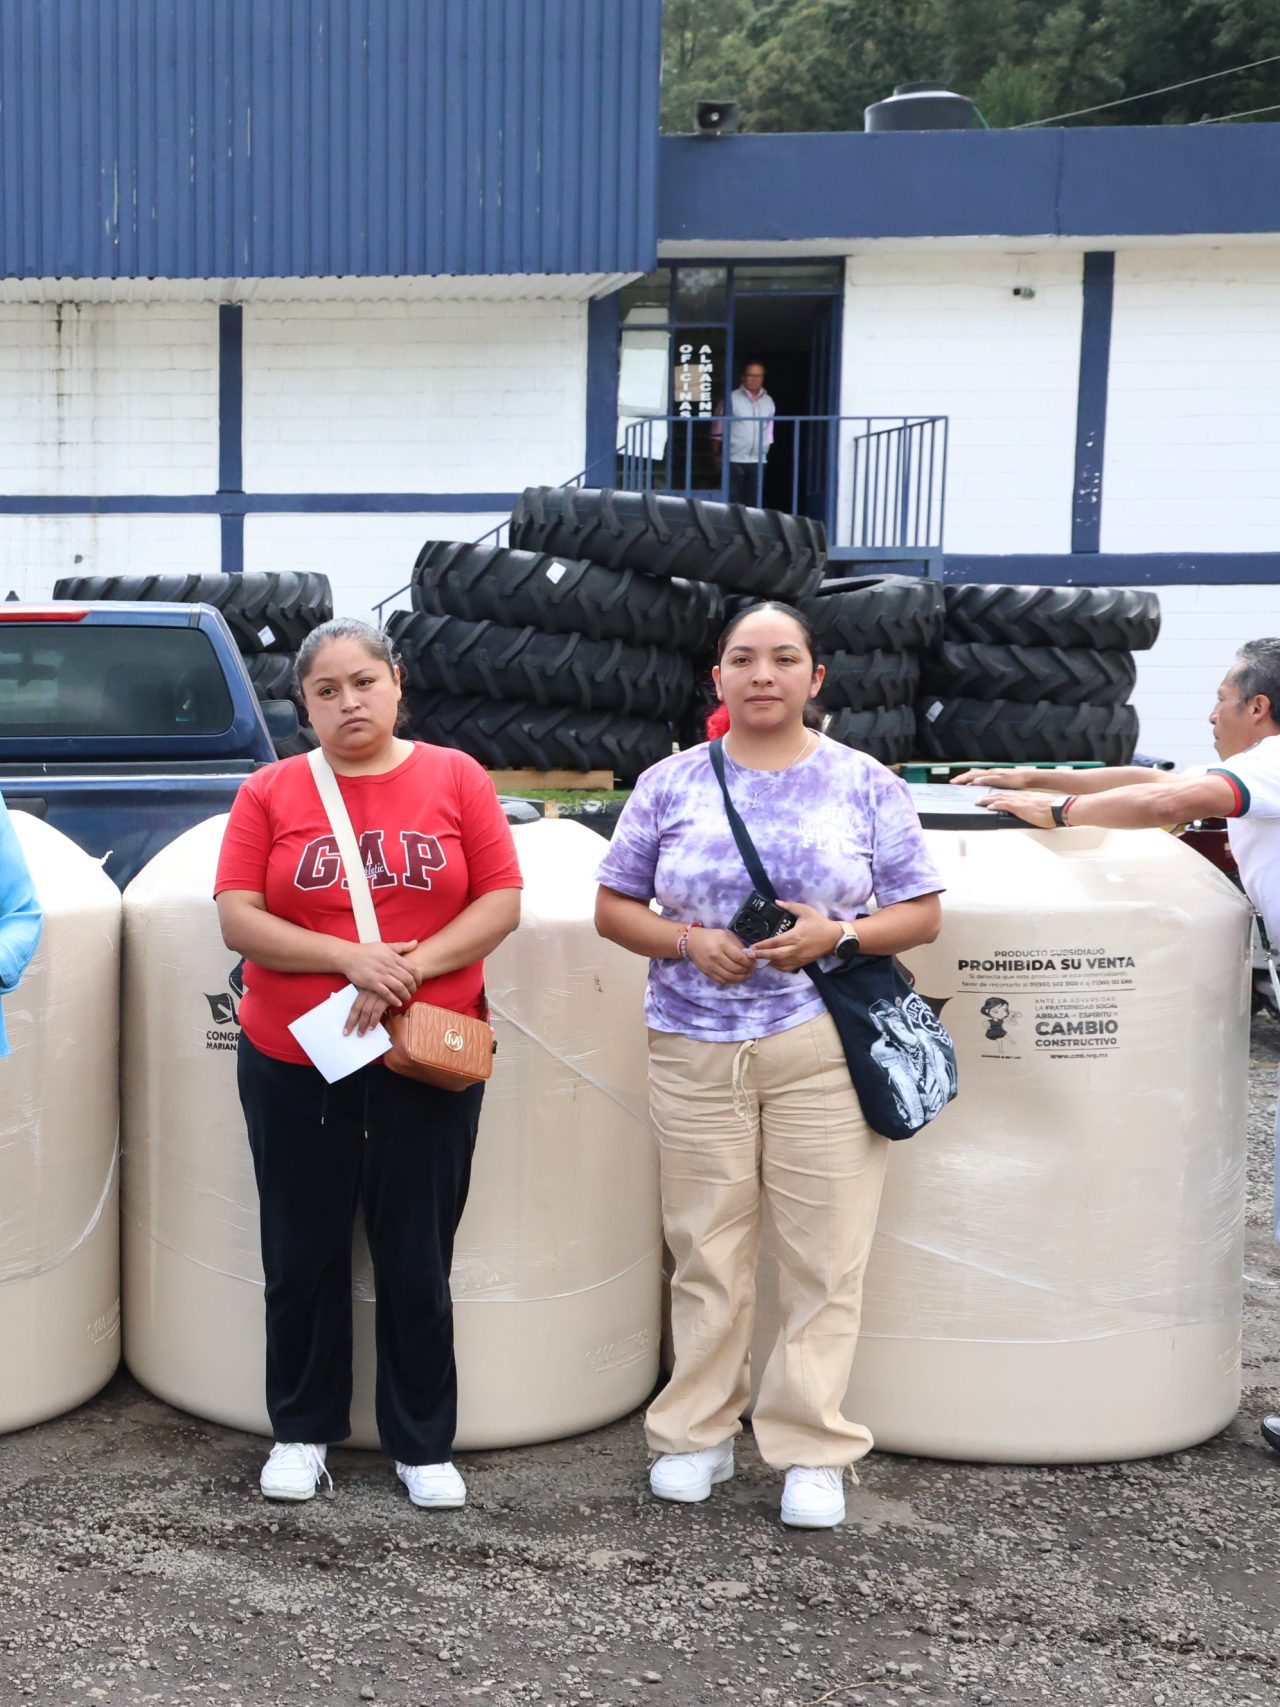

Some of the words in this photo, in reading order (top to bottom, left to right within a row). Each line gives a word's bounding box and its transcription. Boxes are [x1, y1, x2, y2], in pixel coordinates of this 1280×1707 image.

[679, 344, 692, 417] OFICINAS
[294, 830, 447, 890] GAP
[994, 949, 1048, 958] PRODUCTO
[958, 959, 1056, 972] PROHIBIDA
[1060, 958, 1082, 971] SU
[1086, 956, 1136, 969] VENTA
[1035, 1019, 1119, 1036] CAMBIO
[1035, 1037, 1118, 1047] CONSTRUCTIVO
